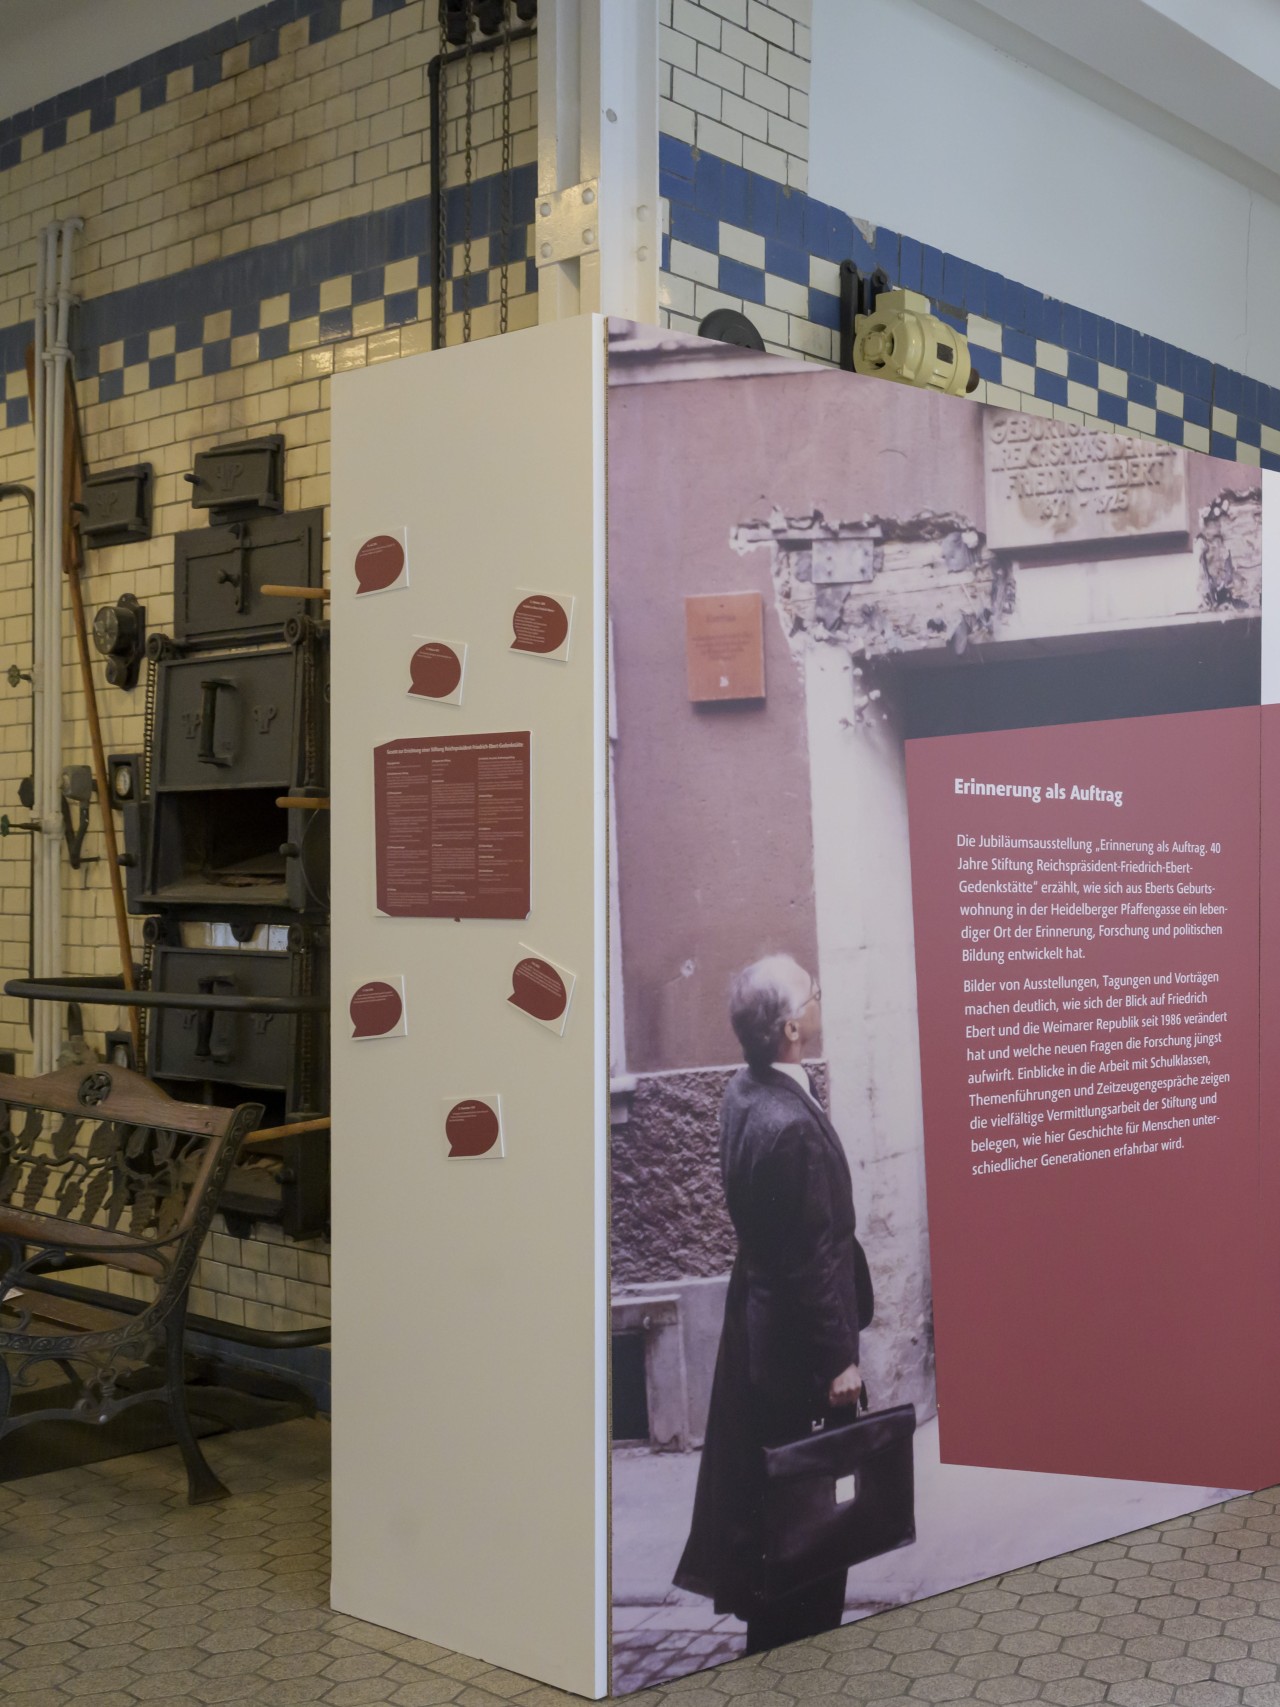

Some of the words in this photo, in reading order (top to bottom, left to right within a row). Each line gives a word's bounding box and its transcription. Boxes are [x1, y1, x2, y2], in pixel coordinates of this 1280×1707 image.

[954, 777, 1041, 803] Erinnerung
[1045, 782, 1066, 799] als
[1069, 784, 1123, 807] Auftrag
[956, 834, 976, 847] Die
[978, 834, 1092, 854] Jubiläumsausstellung
[1156, 840, 1169, 853] als
[1171, 840, 1207, 856] Auftrag.
[1210, 842, 1221, 854] 40
[957, 856, 988, 870] Jahre
[991, 857, 1034, 875] Stiftung
[1036, 858, 1193, 875] Reichspräsident-Friedrich-Ebert-
[1040, 880, 1080, 895] erzählt,
[1082, 884, 1101, 893] wie
[1103, 881, 1123, 893] sich
[1125, 884, 1143, 894] aus
[1144, 881, 1174, 894] Eberts
[1176, 882, 1215, 894] Geburts-
[959, 902, 1013, 919] wohnung
[1016, 906, 1027, 915] in
[1029, 902, 1048, 915] der
[1050, 902, 1118, 919] Heidelberger
[1120, 902, 1181, 918] Pfaffengasse
[1182, 905, 1197, 915] ein
[1199, 902, 1228, 915] leben-
[960, 925, 991, 942] diger
[993, 925, 1012, 938] Ort
[1014, 924, 1033, 938] der
[1035, 925, 1096, 940] Erinnerung,
[1098, 923, 1149, 940] Forschung
[1151, 923, 1171, 936] und
[1173, 922, 1223, 939] politischen
[962, 948, 1005, 965] Bildung
[1007, 946, 1063, 960] entwickelt
[1065, 946, 1085, 959] hat.
[963, 978, 996, 992] Bilder
[999, 980, 1020, 991] von
[1023, 975, 1099, 992] Ausstellungen,
[1102, 974, 1151, 990] Tagungen
[1153, 971, 1172, 985] und
[1174, 972, 1219, 986] Vorträgen
[965, 1024, 995, 1038] Ebert
[998, 1022, 1020, 1036] und
[1022, 1021, 1040, 1034] die
[1042, 1021, 1094, 1034] Weimarer
[1096, 1015, 1139, 1032] Republik
[1141, 1014, 1158, 1027] seit
[1160, 1013, 1182, 1026] 1986
[1183, 1010, 1227, 1024] verändert
